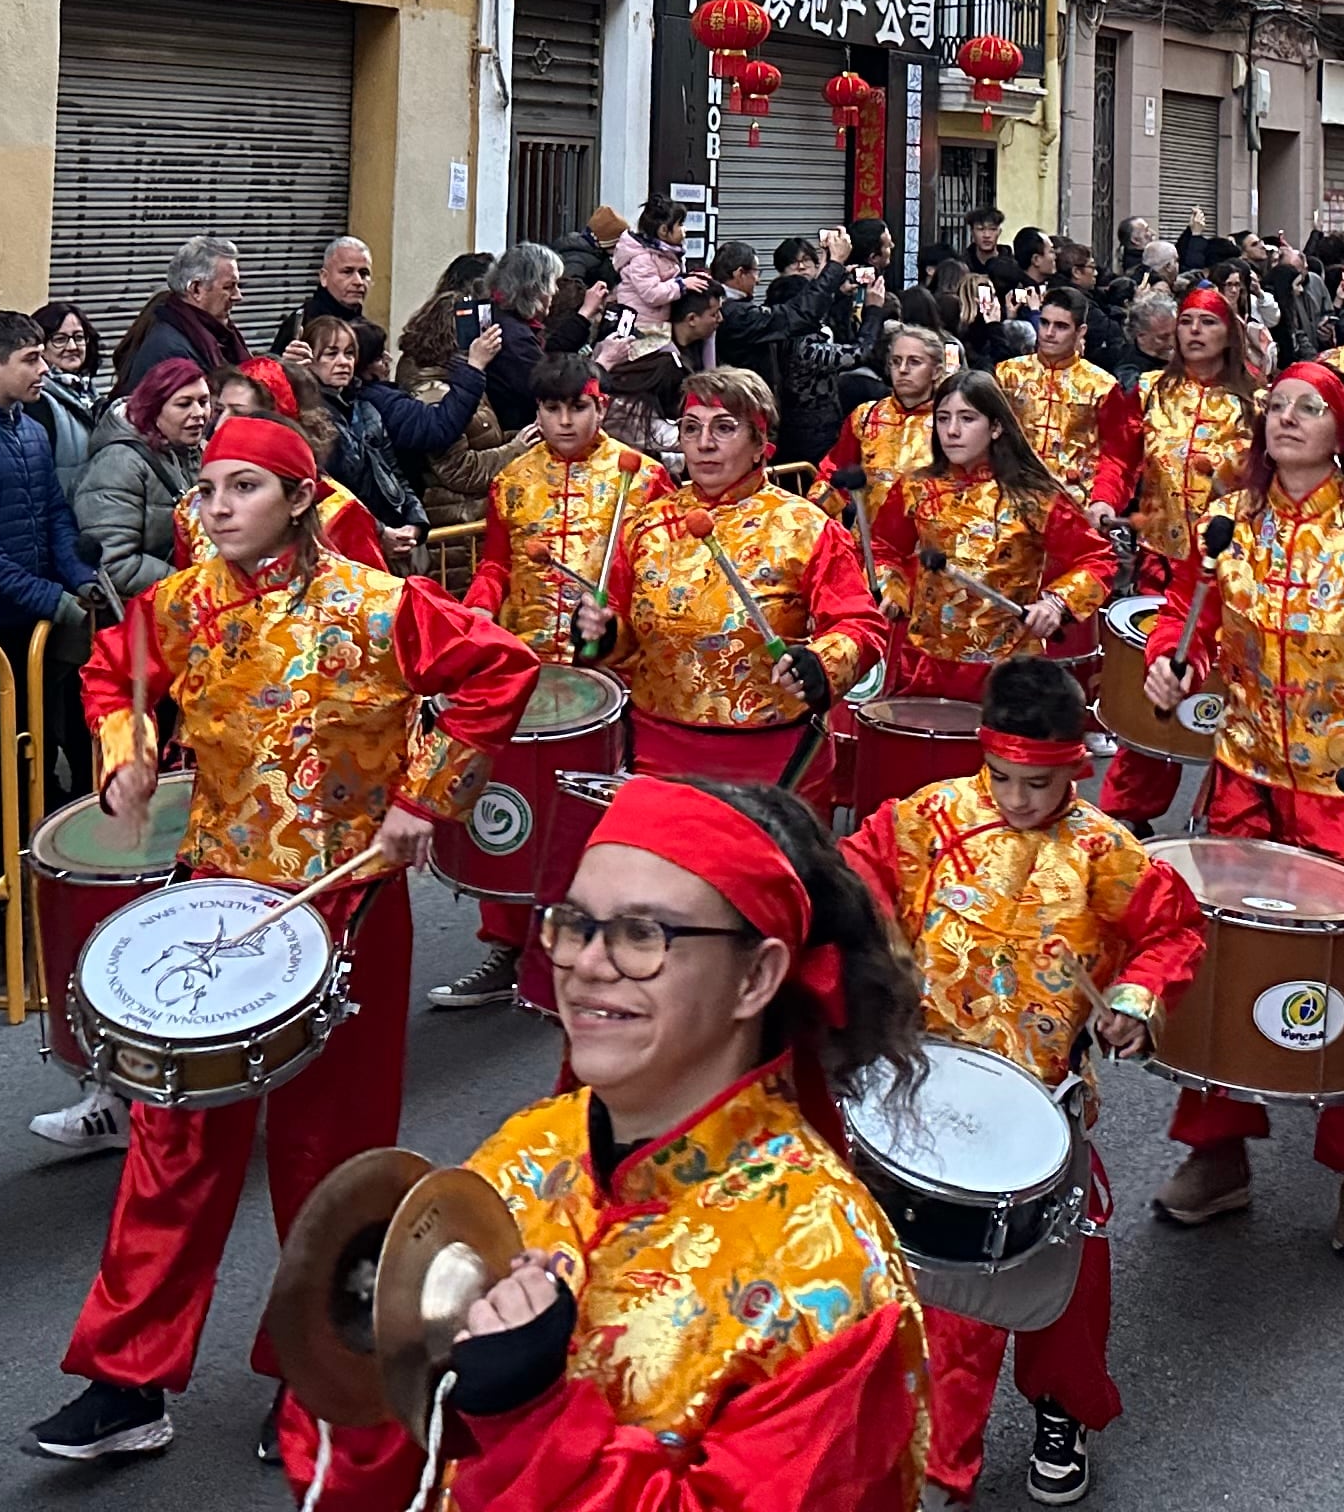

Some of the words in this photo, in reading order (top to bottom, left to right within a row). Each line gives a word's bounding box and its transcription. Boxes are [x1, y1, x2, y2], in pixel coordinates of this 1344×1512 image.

[139, 906, 177, 929] SPAIN
[188, 901, 257, 914] VALENCIA
[106, 935, 133, 975] CAMPUS
[166, 990, 278, 1025] INTERNATIONAL
